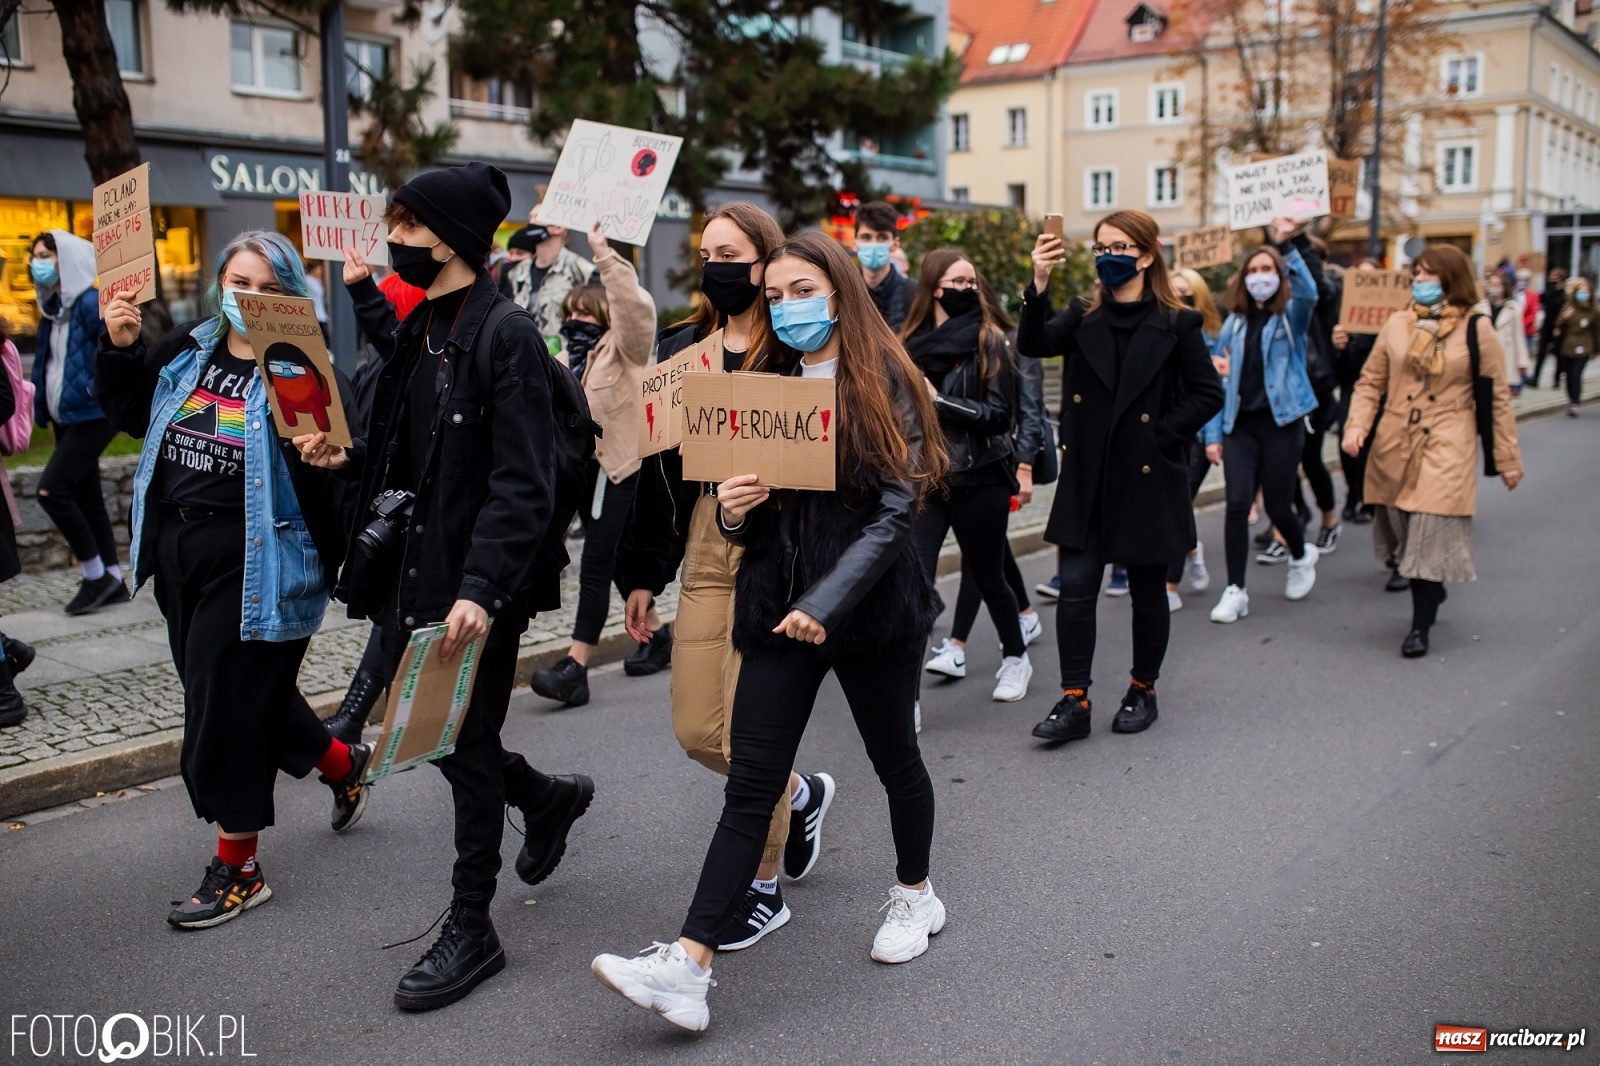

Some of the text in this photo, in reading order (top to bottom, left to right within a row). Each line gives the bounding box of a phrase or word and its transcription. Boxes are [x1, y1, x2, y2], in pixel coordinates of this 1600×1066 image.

[210, 154, 320, 195] SALON
[103, 178, 137, 211] POLAND
[98, 200, 137, 230] MADE ME SAY:
[95, 213, 142, 252] JEBAĆ PIS
[306, 224, 360, 250] KOBIET
[239, 296, 308, 317] KAJA GODEK
[246, 320, 321, 336] WAS AN IMPOSTOR
[642, 361, 690, 398] PROTEST
[174, 433, 196, 448] SIDE
[196, 439, 207, 451] OF
[209, 442, 229, 458] THE
[232, 449, 246, 461] M
[179, 447, 213, 473] TOUR
